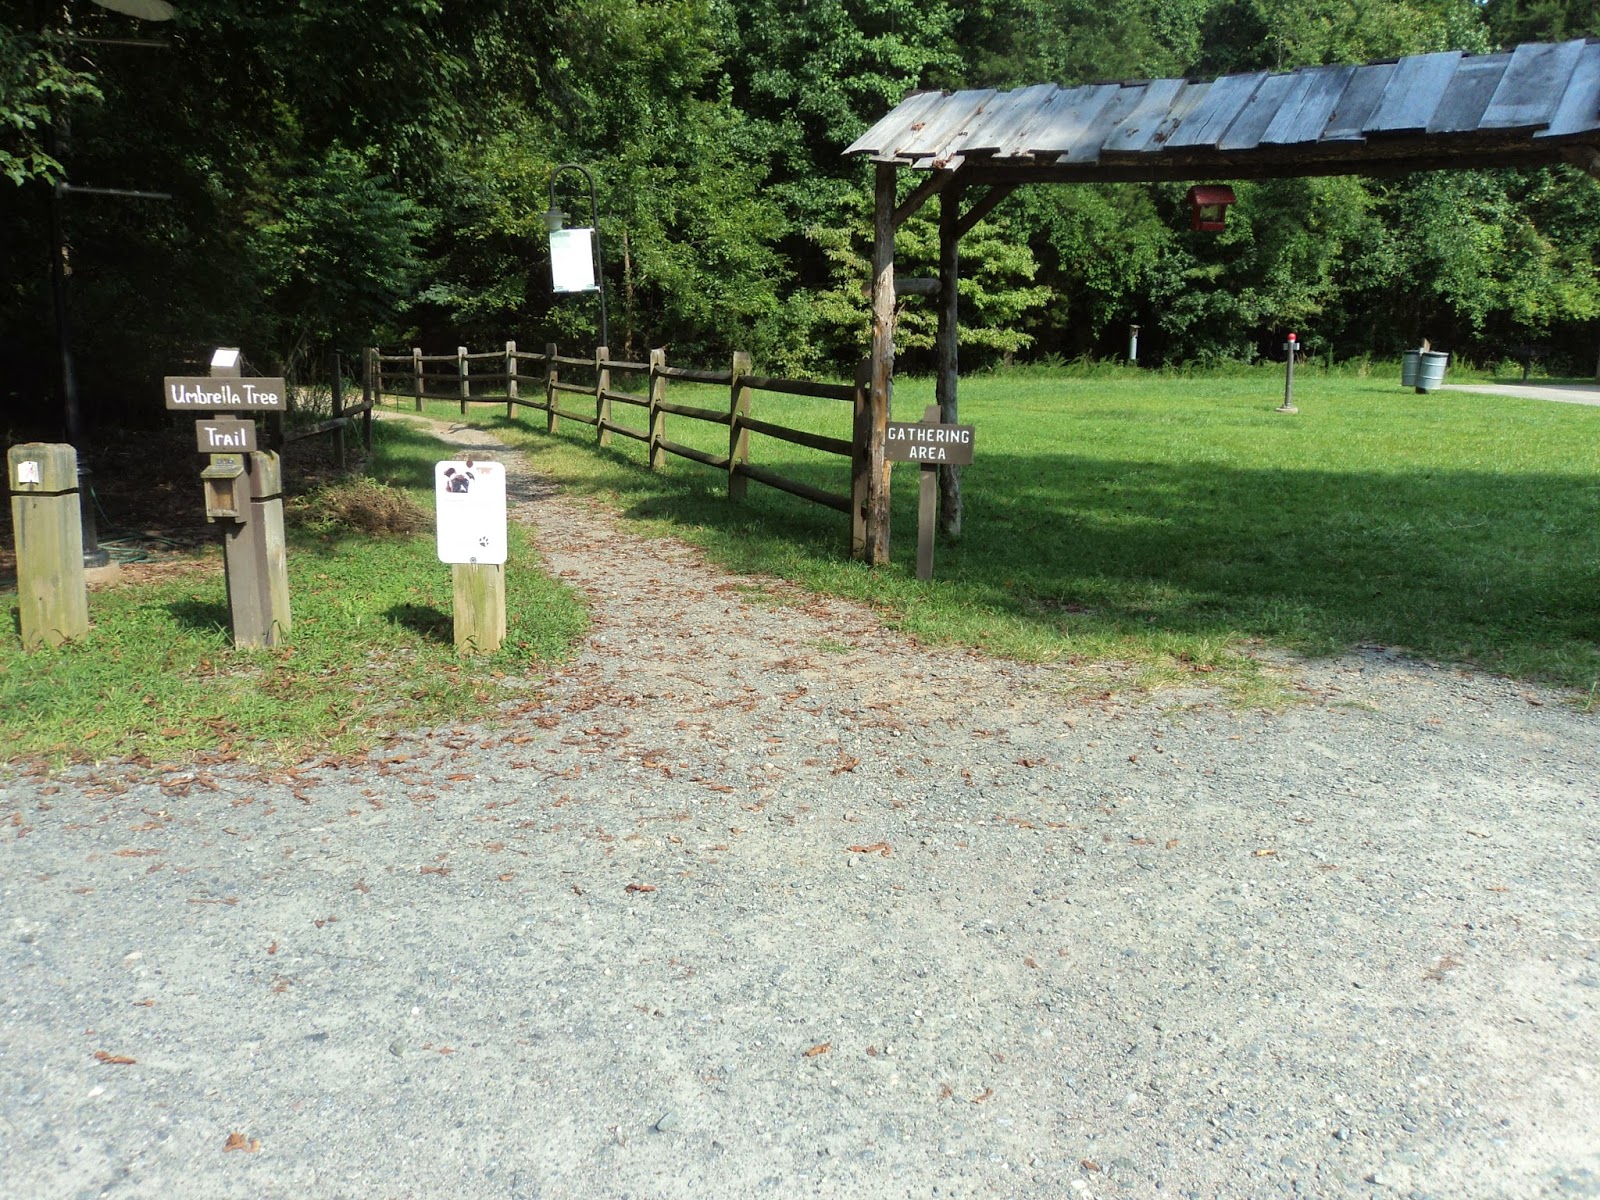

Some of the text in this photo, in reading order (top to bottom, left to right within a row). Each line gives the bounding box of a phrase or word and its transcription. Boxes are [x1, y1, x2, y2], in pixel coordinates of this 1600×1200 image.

[242, 384, 278, 404] Tree
[888, 427, 970, 444] GATHERING
[909, 446, 946, 460] AREA
